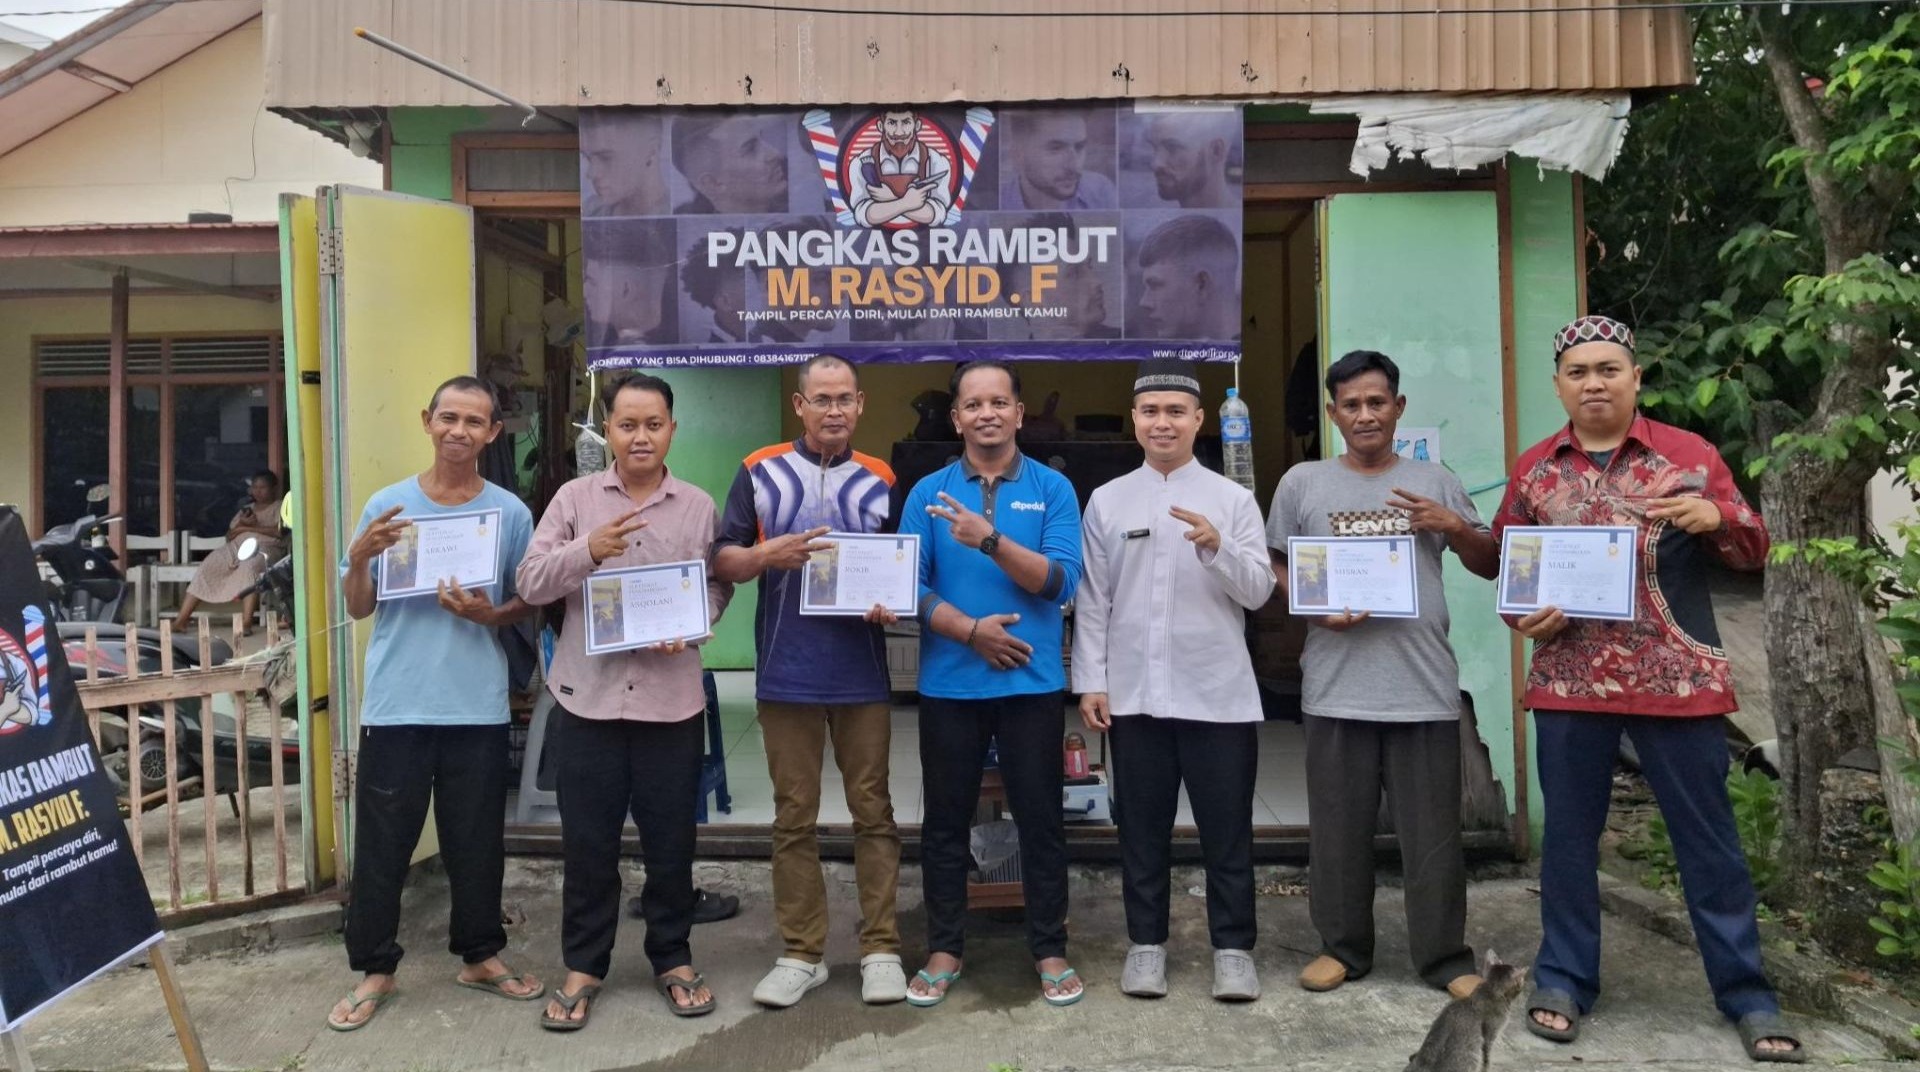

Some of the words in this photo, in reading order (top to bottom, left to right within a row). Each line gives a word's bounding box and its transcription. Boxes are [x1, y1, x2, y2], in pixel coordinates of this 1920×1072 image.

[708, 230, 920, 267] PANGKAS
[929, 227, 1117, 265] RAMBUT
[767, 267, 821, 306] M.
[831, 265, 1001, 305] RASYID
[1031, 265, 1058, 304] F
[737, 310, 787, 322] TAMPIL
[790, 309, 850, 321] PERCAYA
[854, 309, 885, 322] DIRI,
[887, 309, 927, 320] MULAI
[930, 308, 961, 320] DARI
[965, 307, 1021, 319] RAMBUT
[1024, 307, 1068, 319] KAMU!
[592, 356, 634, 367] KONTAK
[635, 356, 664, 366] YANG
[666, 356, 688, 365] BISA
[690, 354, 746, 365] DIHUBUNGI
[26, 743, 96, 793] RAMBUT
[11, 794, 76, 845] RASYID
[69, 789, 90, 821] F.
[2, 854, 41, 881] Tampil
[41, 837, 82, 868] percaya
[82, 827, 101, 845] diri,
[28, 870, 50, 891] dari
[50, 854, 89, 880] rambut
[87, 839, 119, 865] kamu!
